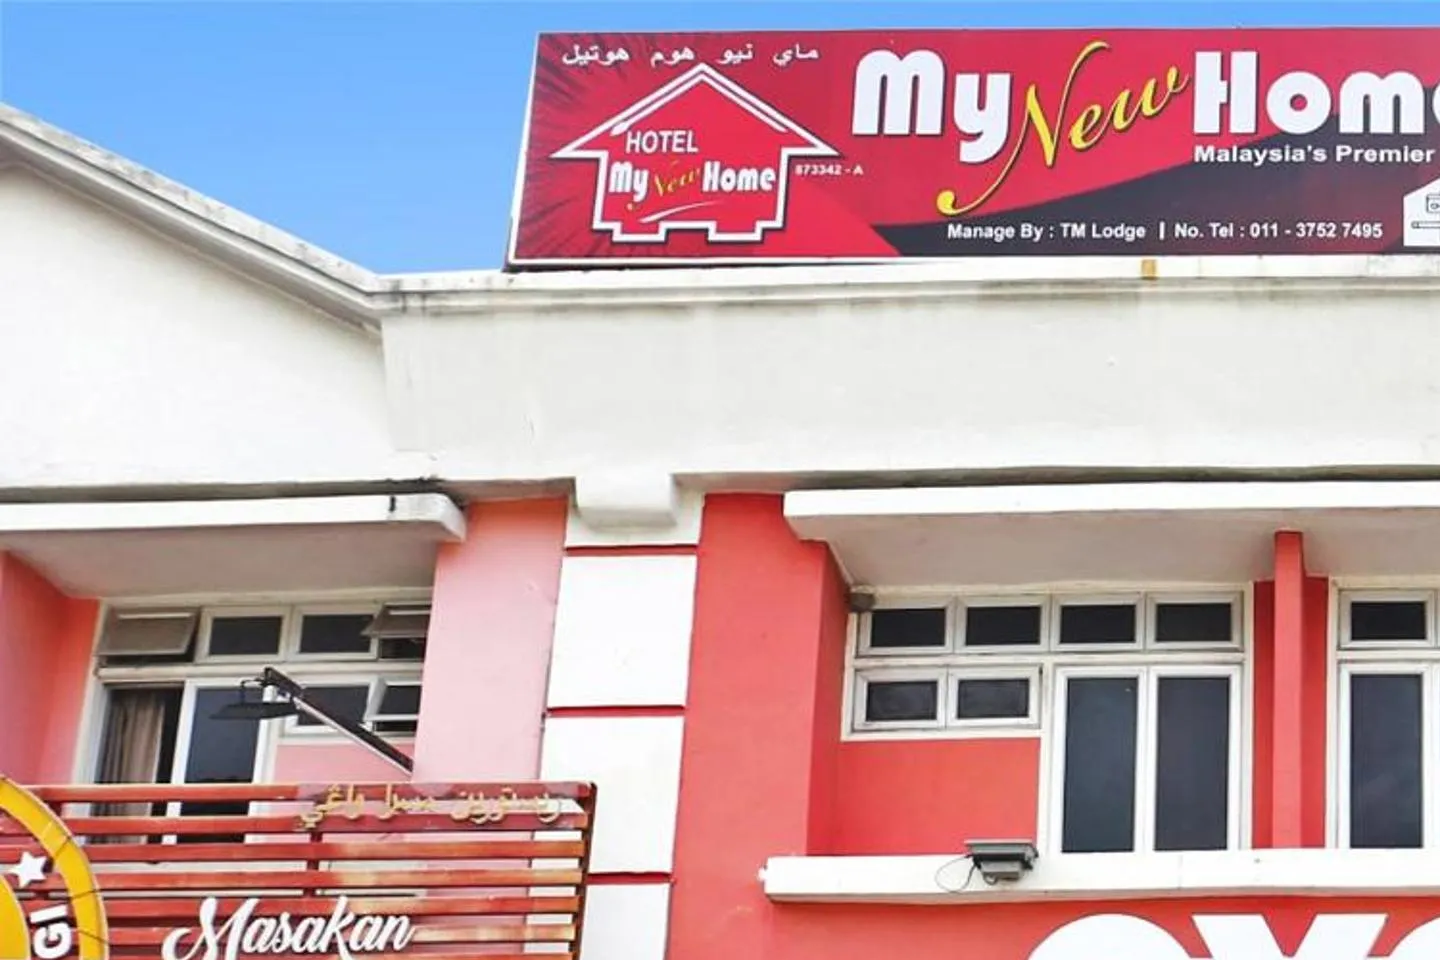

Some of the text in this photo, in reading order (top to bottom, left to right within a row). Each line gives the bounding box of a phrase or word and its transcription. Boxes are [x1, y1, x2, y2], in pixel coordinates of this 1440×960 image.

[650, 47, 695, 68] هوم
[852, 50, 1011, 163] My
[936, 41, 1189, 215] New
[625, 131, 699, 153] HOTEL
[1194, 144, 1327, 166] Malaysia's
[1335, 144, 1436, 163] Premier
[608, 161, 649, 202] My
[702, 161, 777, 193] Home
[947, 222, 1016, 243] Manage
[1020, 222, 1044, 242] By
[1059, 222, 1086, 239] TM
[1091, 222, 1147, 242] Lodge
[1174, 222, 1204, 239] No.
[1208, 222, 1234, 239] Tel
[1249, 222, 1278, 239] 011
[1295, 222, 1337, 239] 3752
[1341, 222, 1383, 239] 7495
